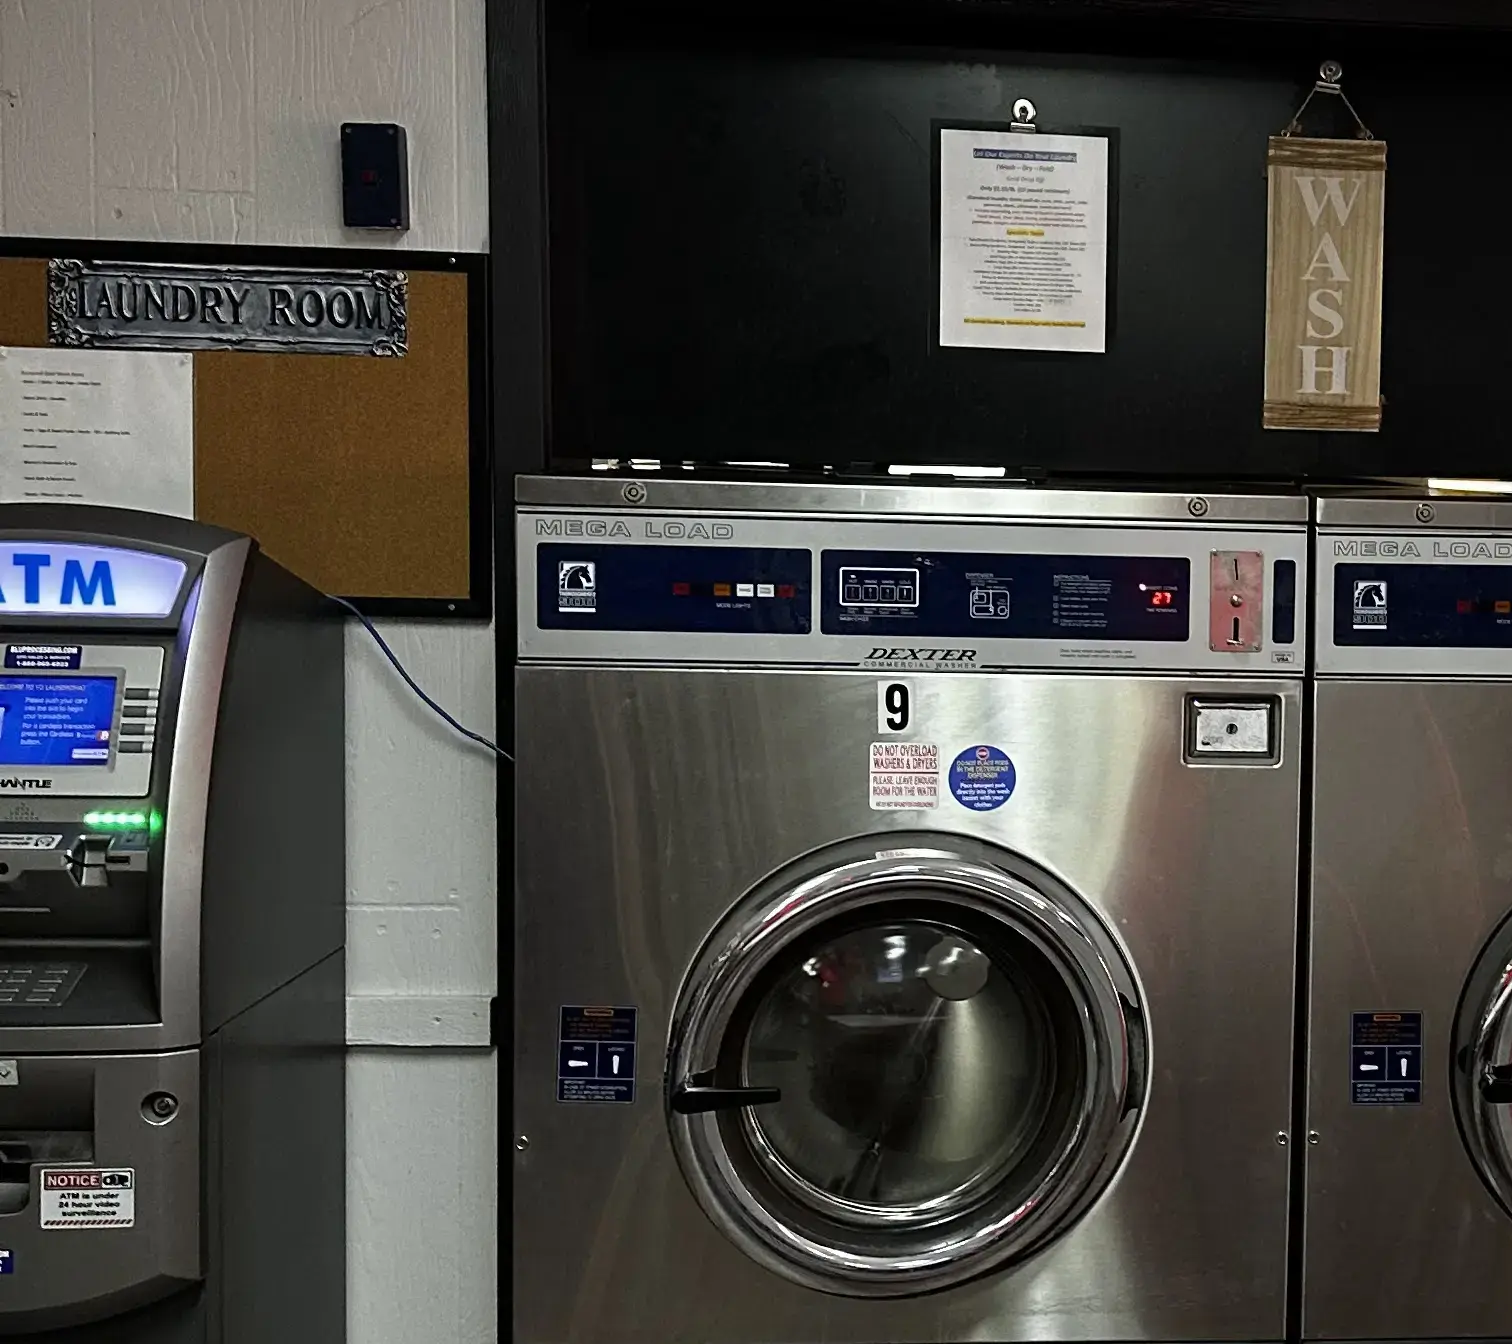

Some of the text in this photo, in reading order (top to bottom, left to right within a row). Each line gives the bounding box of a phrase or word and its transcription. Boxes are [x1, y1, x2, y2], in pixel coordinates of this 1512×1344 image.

[1294, 176, 1361, 396] WASH
[77, 279, 388, 330] LAUNDRY ROOM
[535, 518, 733, 540] MEGA LOAD
[1334, 541, 1420, 557] MEGA
[0, 552, 117, 606] TM
[864, 648, 977, 661] DEXTER
[885, 683, 909, 731] 9
[873, 745, 937, 757] DO NOT OVERLOAD
[873, 757, 905, 769] WASHERS
[912, 758, 937, 769] DRYERS
[47, 1175, 100, 1186] NOTICE
